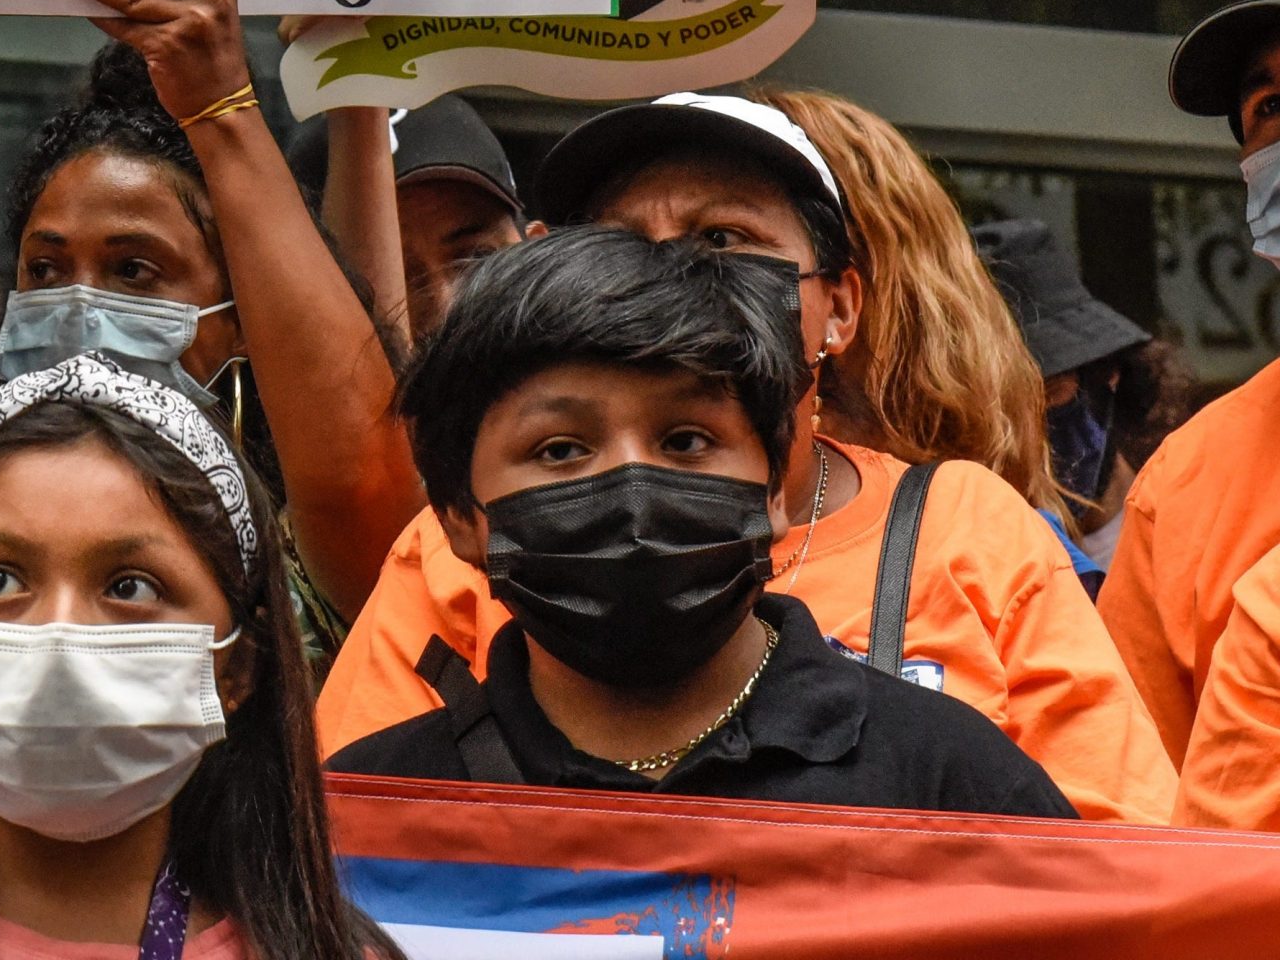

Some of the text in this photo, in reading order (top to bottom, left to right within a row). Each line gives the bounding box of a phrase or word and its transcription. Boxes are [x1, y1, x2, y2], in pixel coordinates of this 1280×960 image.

[382, 5, 757, 52] DIGNIDAD, COMUNIDAD Y PODER
